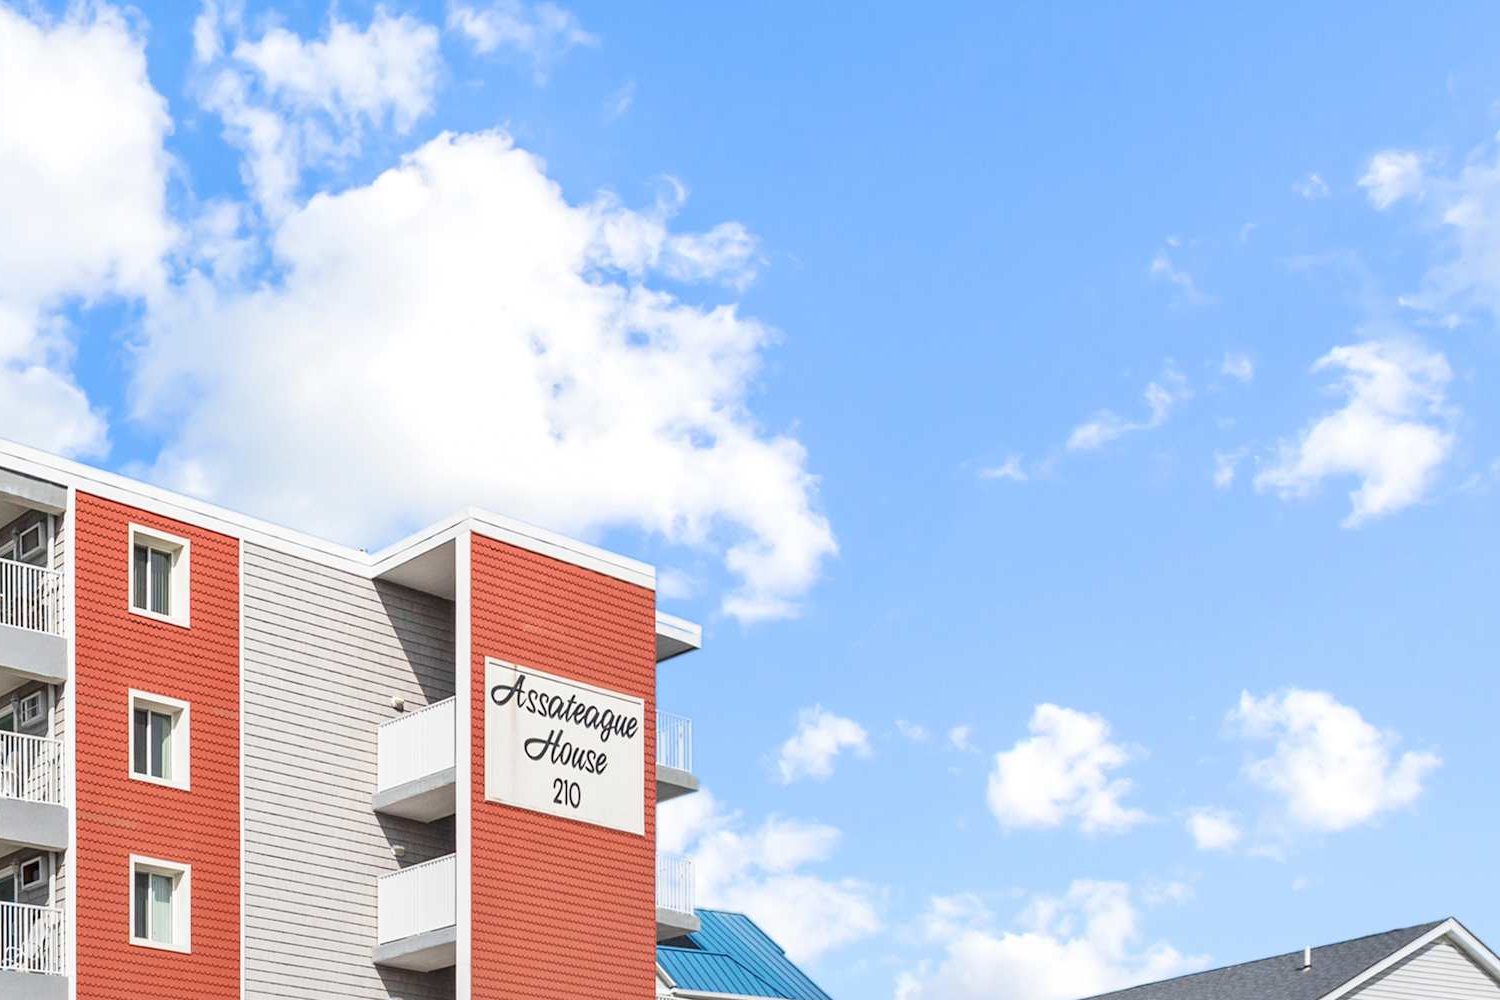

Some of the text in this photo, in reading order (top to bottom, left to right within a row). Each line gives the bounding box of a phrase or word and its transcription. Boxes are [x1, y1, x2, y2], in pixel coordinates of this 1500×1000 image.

[491, 674, 639, 743] Assateague
[524, 729, 608, 775] House
[553, 777, 581, 809] 210
